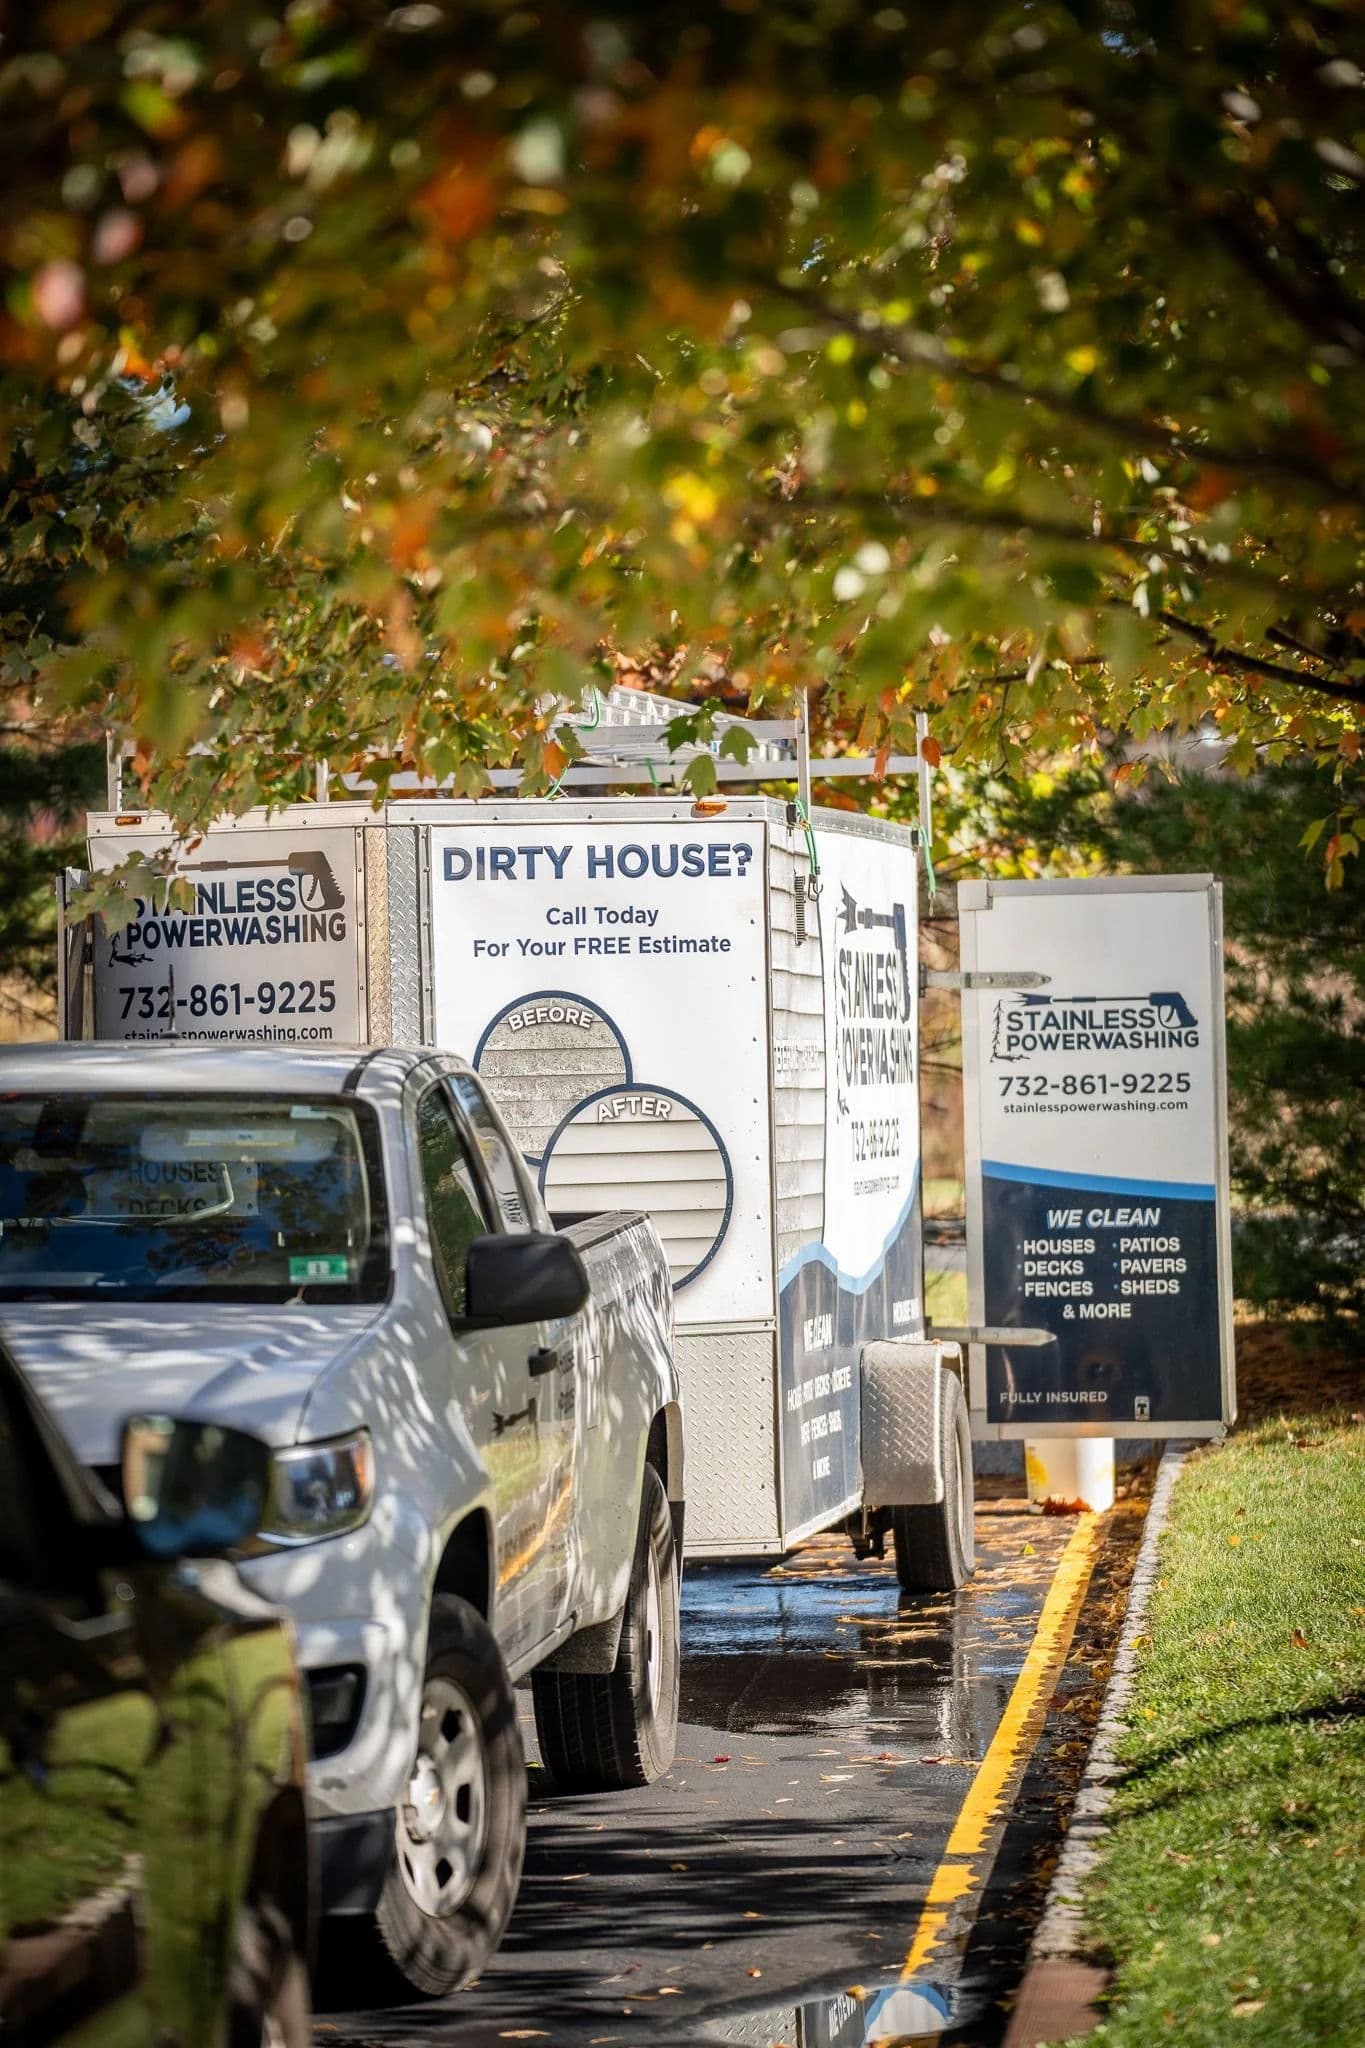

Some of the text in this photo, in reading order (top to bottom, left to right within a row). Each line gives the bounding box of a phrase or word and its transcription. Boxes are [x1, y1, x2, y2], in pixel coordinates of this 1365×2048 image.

[443, 843, 753, 881] DIRTY HOUSE?
[133, 877, 296, 919] NLESS
[546, 905, 659, 927] Call Today
[126, 912, 346, 950] POWERWASHING
[473, 935, 731, 957] For Your FREE Estimate
[119, 980, 336, 1019] 732-861-9225
[508, 1006, 595, 1032] BEFORE
[1007, 1008, 1155, 1031] STAINLESS
[1007, 1030, 1200, 1052] POWERWASHING
[999, 1072, 1191, 1097] 732-861-9225
[597, 1096, 672, 1123] AFTER
[1003, 1100, 1188, 1114] stainlesspowerwashing.com
[1047, 1208, 1161, 1229] WE CLEAN
[1023, 1239, 1095, 1255] HOUSES
[1120, 1237, 1180, 1253] PATIOS
[1024, 1260, 1084, 1276] DECKS
[1120, 1258, 1187, 1274] PAVERS
[1025, 1281, 1093, 1297] FENCES
[1120, 1279, 1180, 1295] SHEDS
[1063, 1303, 1131, 1319] & MORE
[1000, 1391, 1108, 1404] FULLY INSURED
